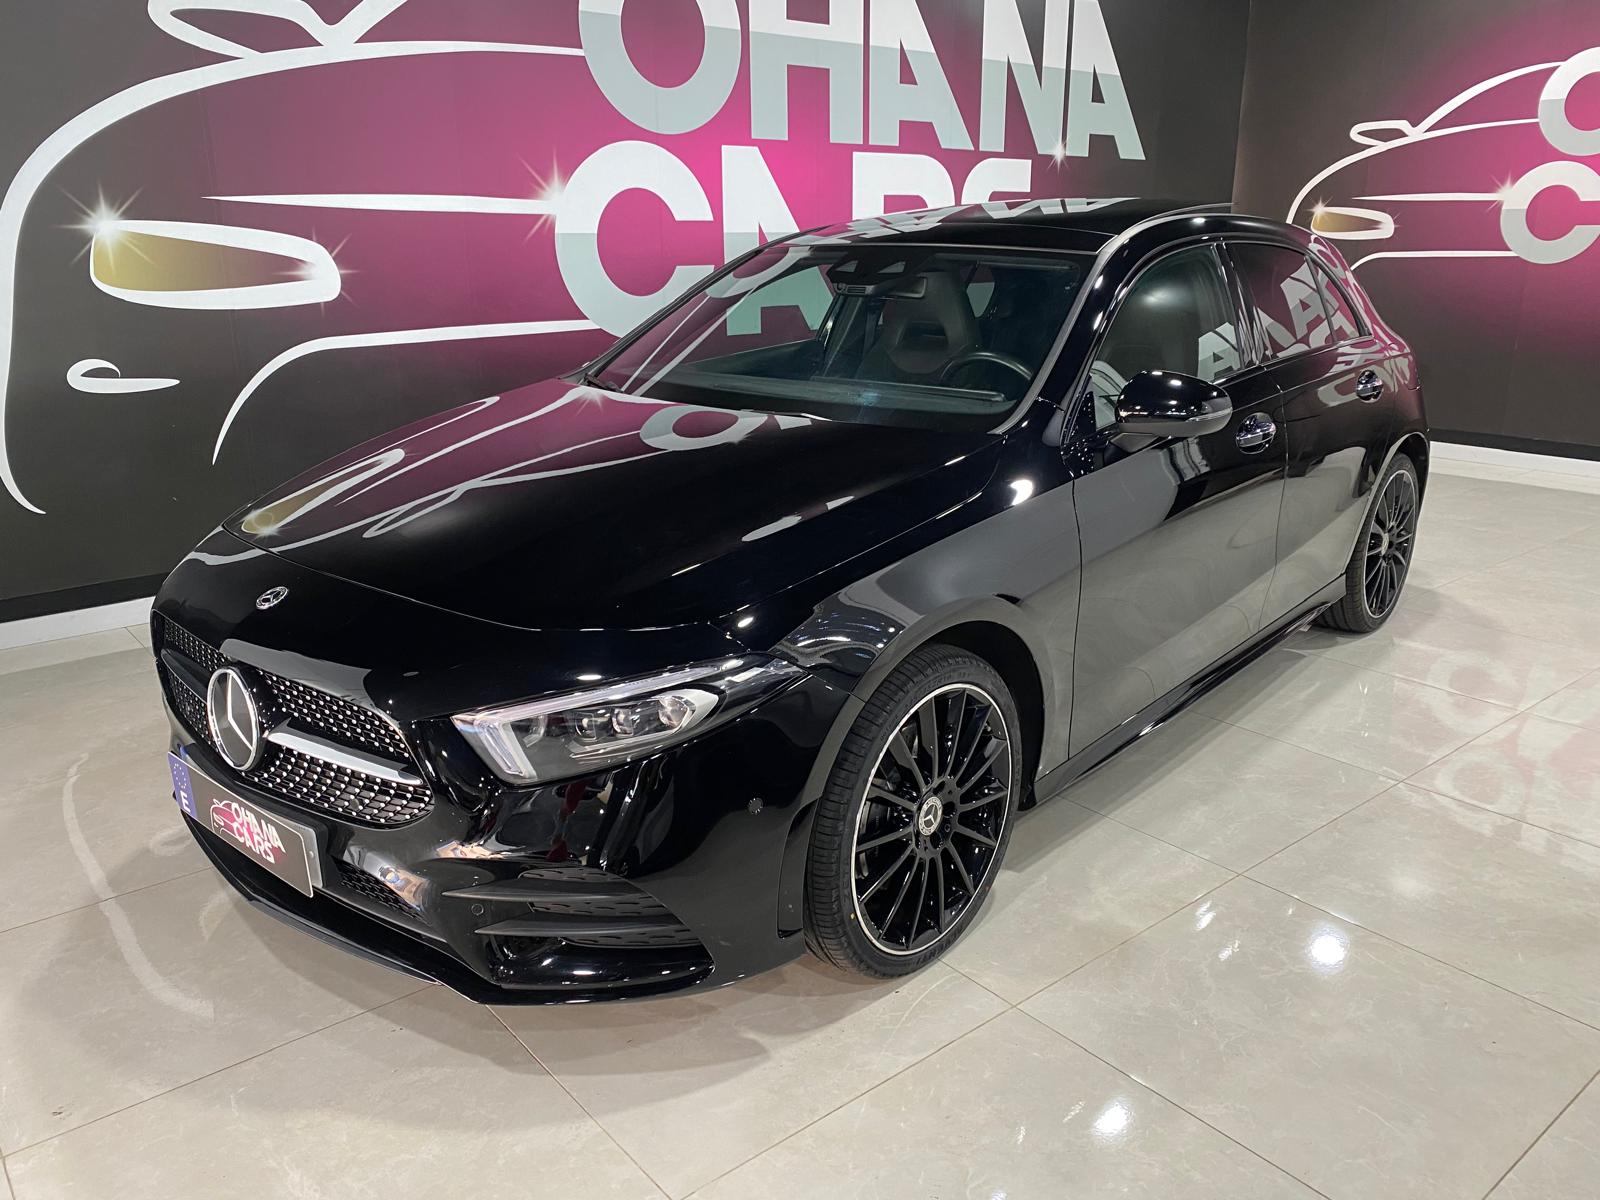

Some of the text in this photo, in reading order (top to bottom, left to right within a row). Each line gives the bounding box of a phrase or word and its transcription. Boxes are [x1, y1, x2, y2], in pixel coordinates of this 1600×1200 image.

[578, 0, 1146, 161] OHANA
[180, 790, 191, 814] E
[231, 802, 286, 853] OHANA
[233, 822, 275, 864] CARS
